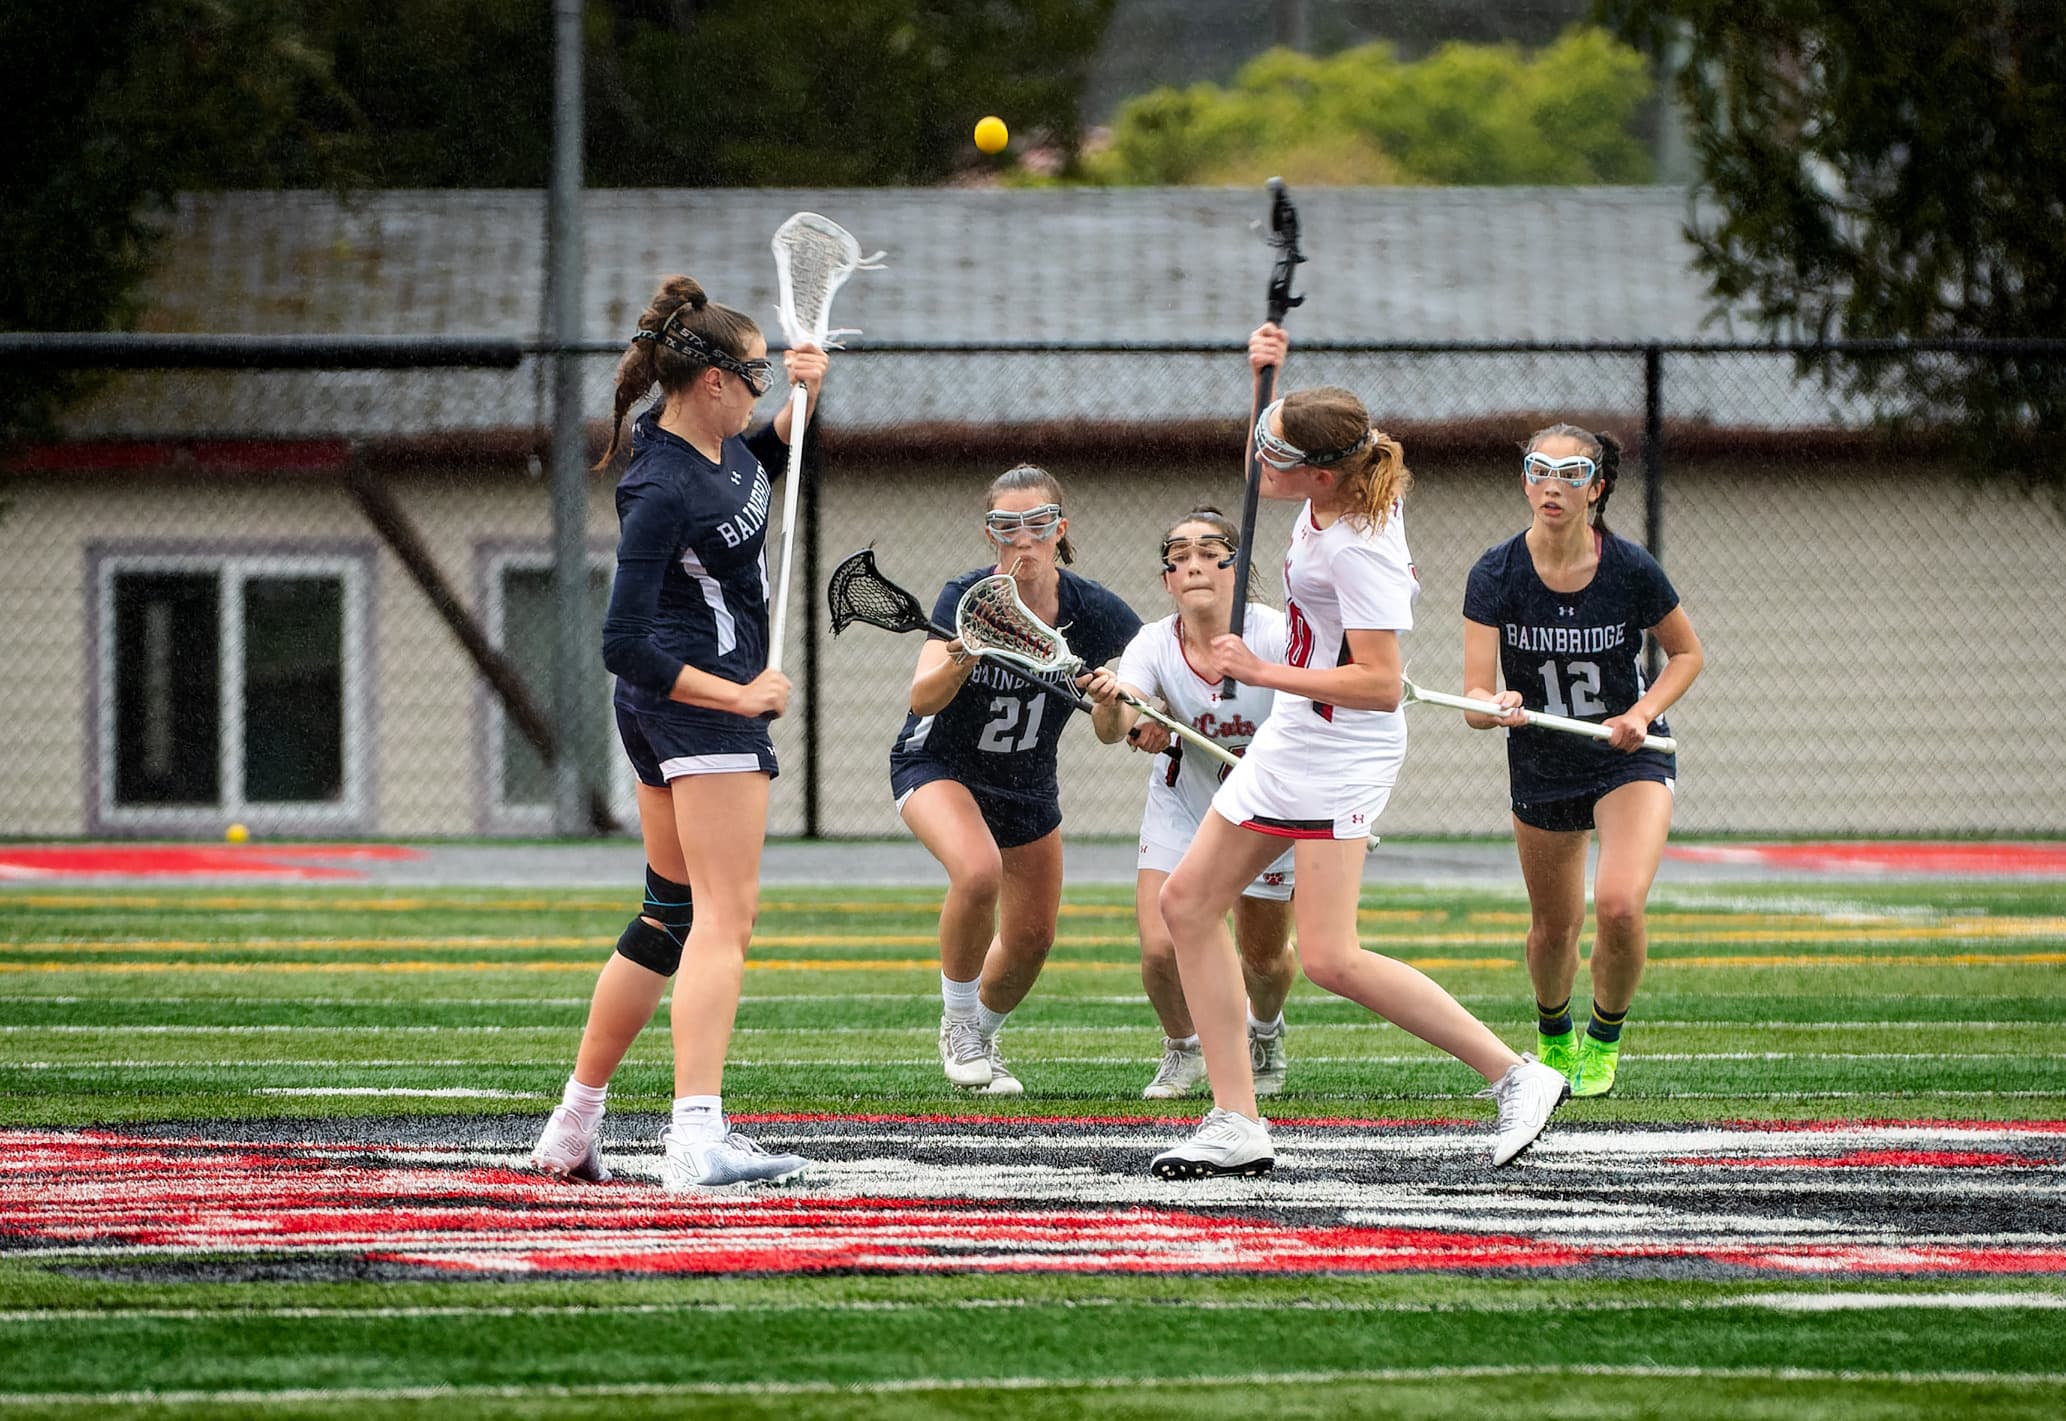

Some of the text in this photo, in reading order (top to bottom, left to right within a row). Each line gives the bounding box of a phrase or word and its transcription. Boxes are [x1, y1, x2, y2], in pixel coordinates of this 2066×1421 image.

[680, 328, 707, 349] STX
[1506, 621, 1626, 653] BAINBRIDGE
[1538, 660, 1608, 717] 12
[977, 692, 1046, 753] 21
